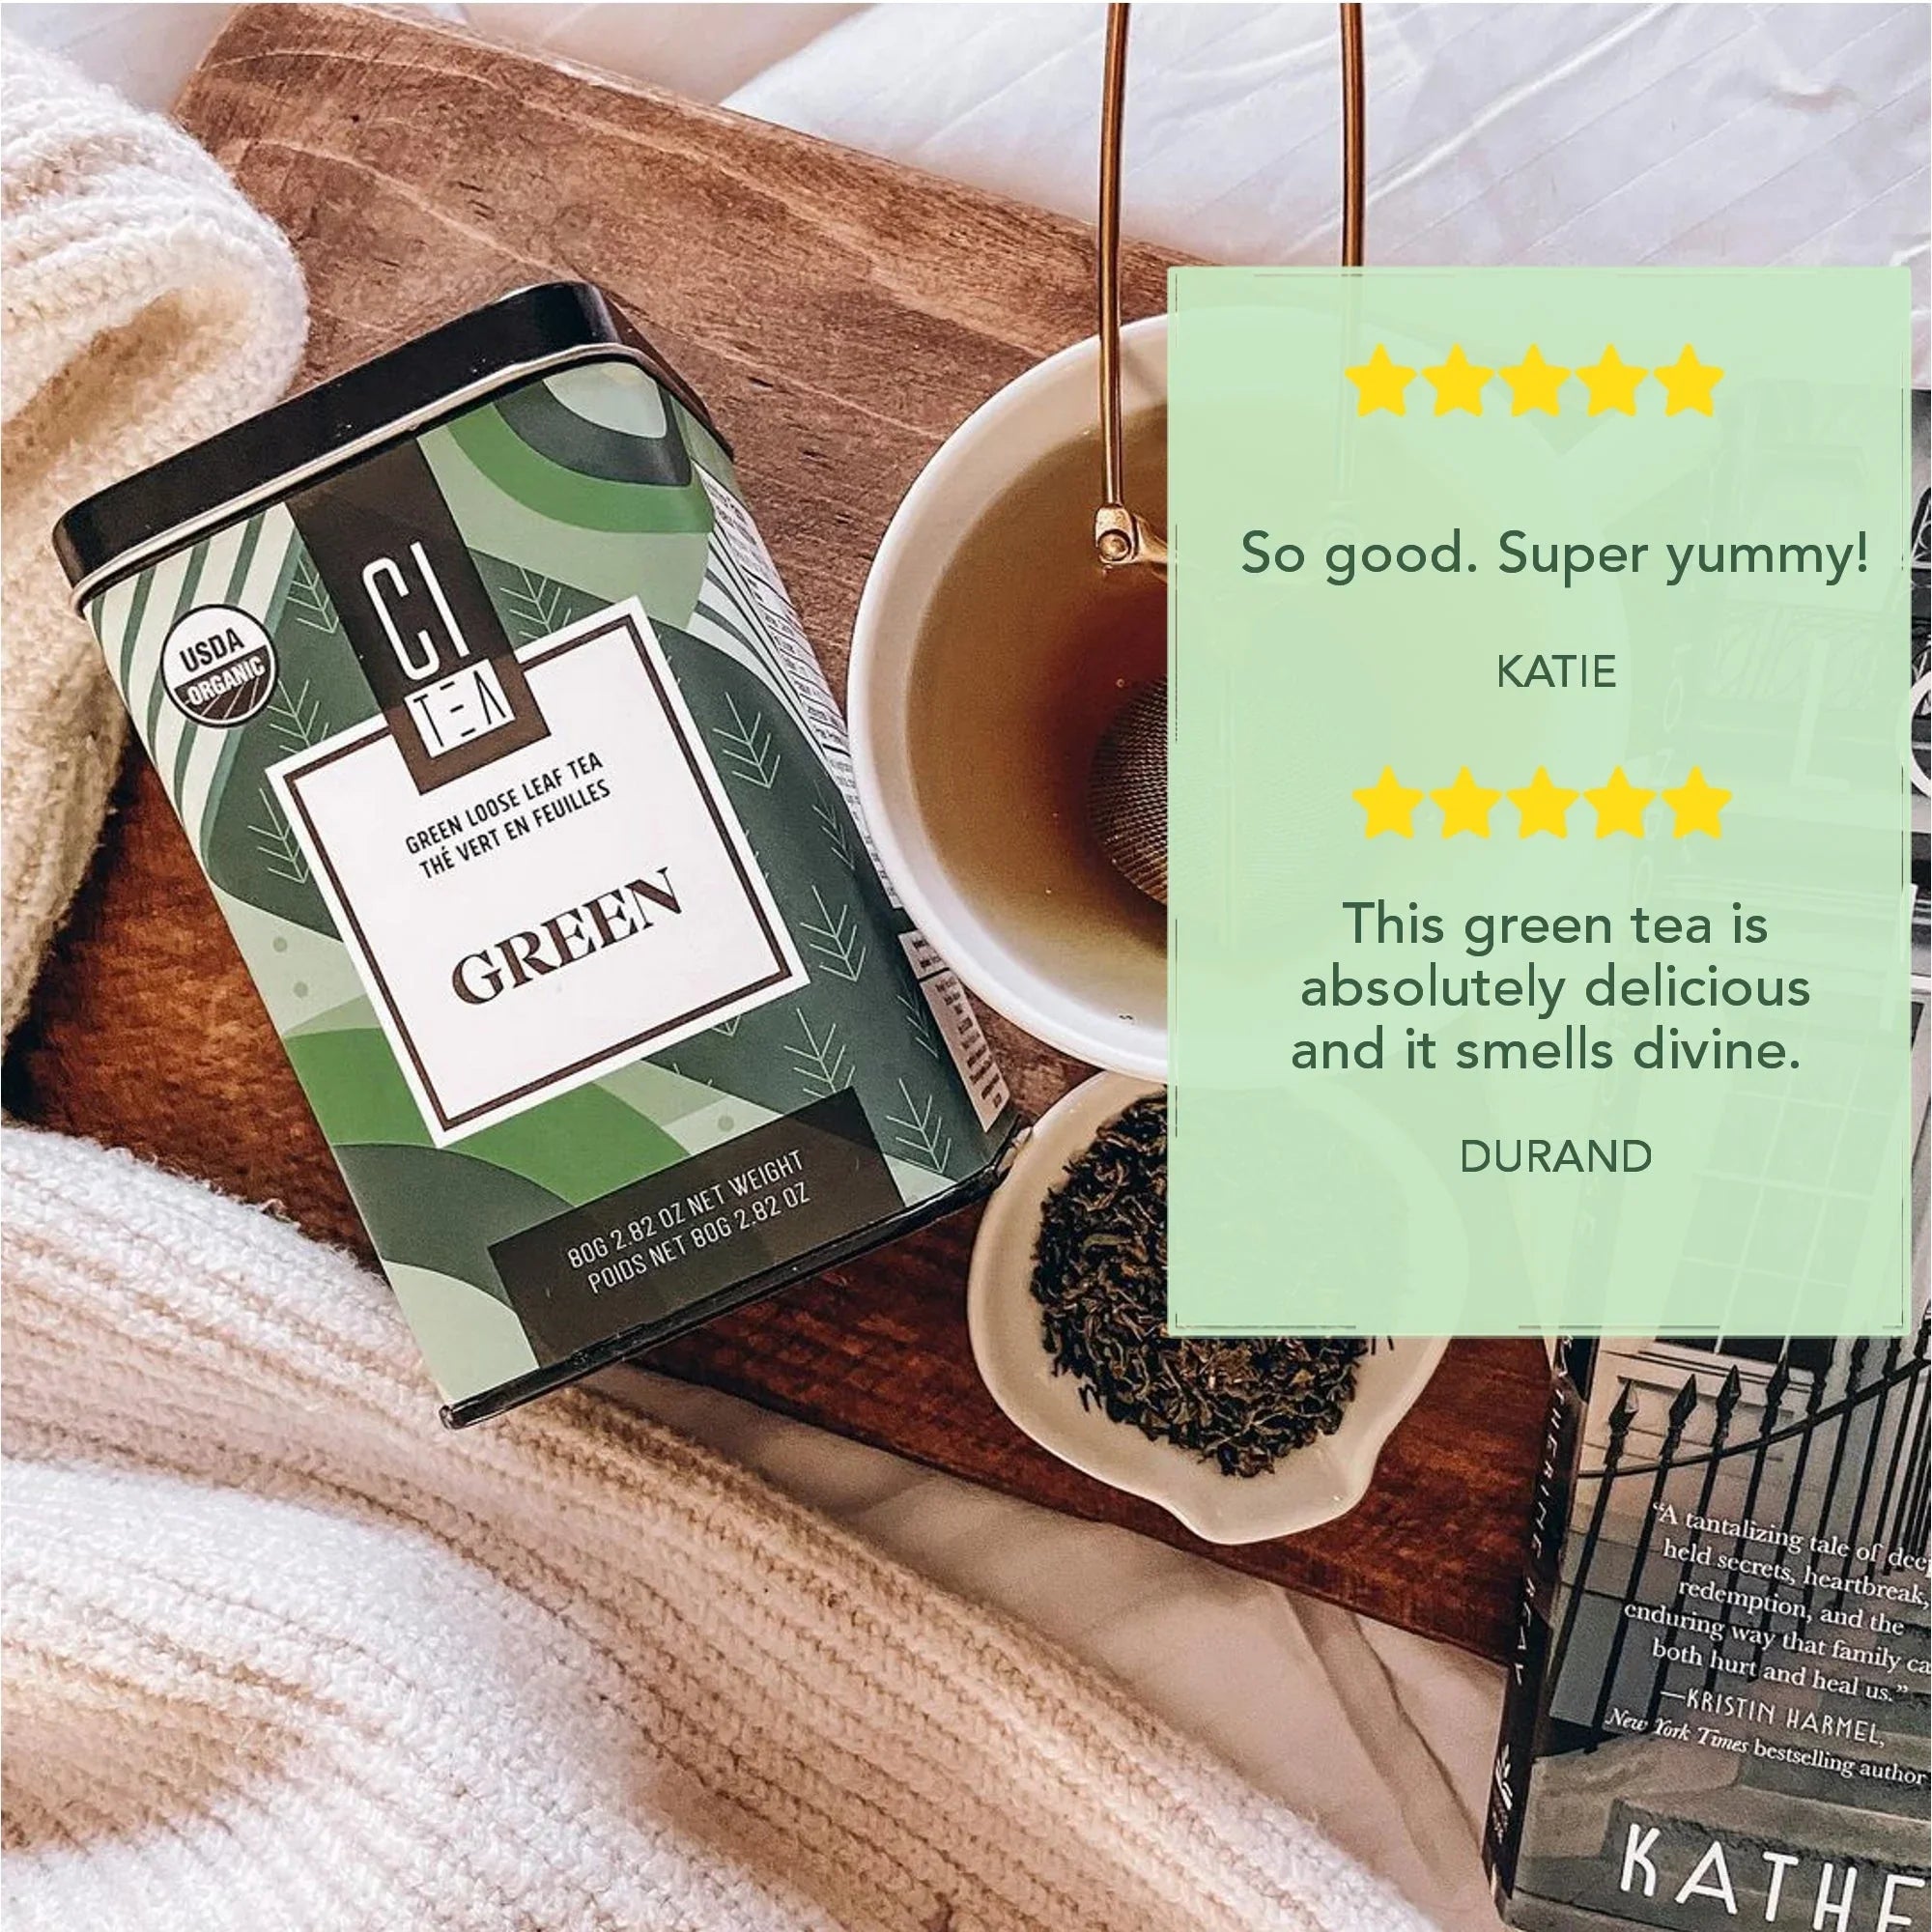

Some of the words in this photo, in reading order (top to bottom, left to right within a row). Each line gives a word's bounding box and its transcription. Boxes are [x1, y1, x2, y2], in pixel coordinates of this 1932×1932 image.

[363, 541, 470, 680] CI
[180, 627, 244, 672] USDA
[186, 656, 266, 705] ORGANIC
[413, 670, 506, 747] TEA
[406, 815, 463, 854] GREEN
[465, 789, 520, 826] LOOSE
[523, 768, 562, 800] LEAF
[567, 753, 603, 779] TEA
[419, 846, 455, 879] THÉ
[456, 829, 500, 861] VERT
[504, 815, 530, 840] EN
[532, 779, 611, 827] FEUILLES
[452, 867, 682, 1005] GREEN
[567, 1236, 609, 1268] 80G
[611, 1216, 657, 1250] 2.82
[658, 1203, 685, 1228] OZ
[687, 1184, 724, 1216] NET
[727, 1150, 803, 1197] WEIGHT
[587, 1254, 647, 1293] POIDS
[648, 1236, 686, 1267] NET
[690, 1217, 732, 1248] 80G
[733, 1196, 781, 1230] 2.82
[783, 1181, 810, 1208] OZ
[1653, 1501, 1678, 1525] “A
[1687, 1511, 1804, 1553] tantalizing
[1810, 1536, 1849, 1557] tale
[1856, 1543, 1884, 1562] of
[1663, 1539, 1711, 1565] held
[1718, 1555, 1796, 1584] secrets,
[1804, 1566, 1930, 1610] heartbreak,
[1679, 1580, 1811, 1623] redemption,
[1820, 1606, 1862, 1630] and
[1870, 1613, 1905, 1635] the
[1624, 1603, 1724, 1640] enduring
[1731, 1626, 1776, 1651] way
[1782, 1633, 1825, 1655] that
[1832, 1639, 1902, 1673] family
[1653, 1638, 1703, 1666] both
[1710, 1649, 1757, 1677] hurt
[1763, 1662, 1805, 1687] and
[1813, 1669, 1859, 1695] heal
[1865, 1684, 1909, 1702] us.”
[1605, 1707, 1649, 1731] New
[1654, 1718, 1691, 1742] York
[1697, 1726, 1749, 1753] Times
[1754, 1738, 1855, 1779] bestselling
[1860, 1761, 1928, 1786] author
[1786, 1707, 1886, 1747] HARMEL,
